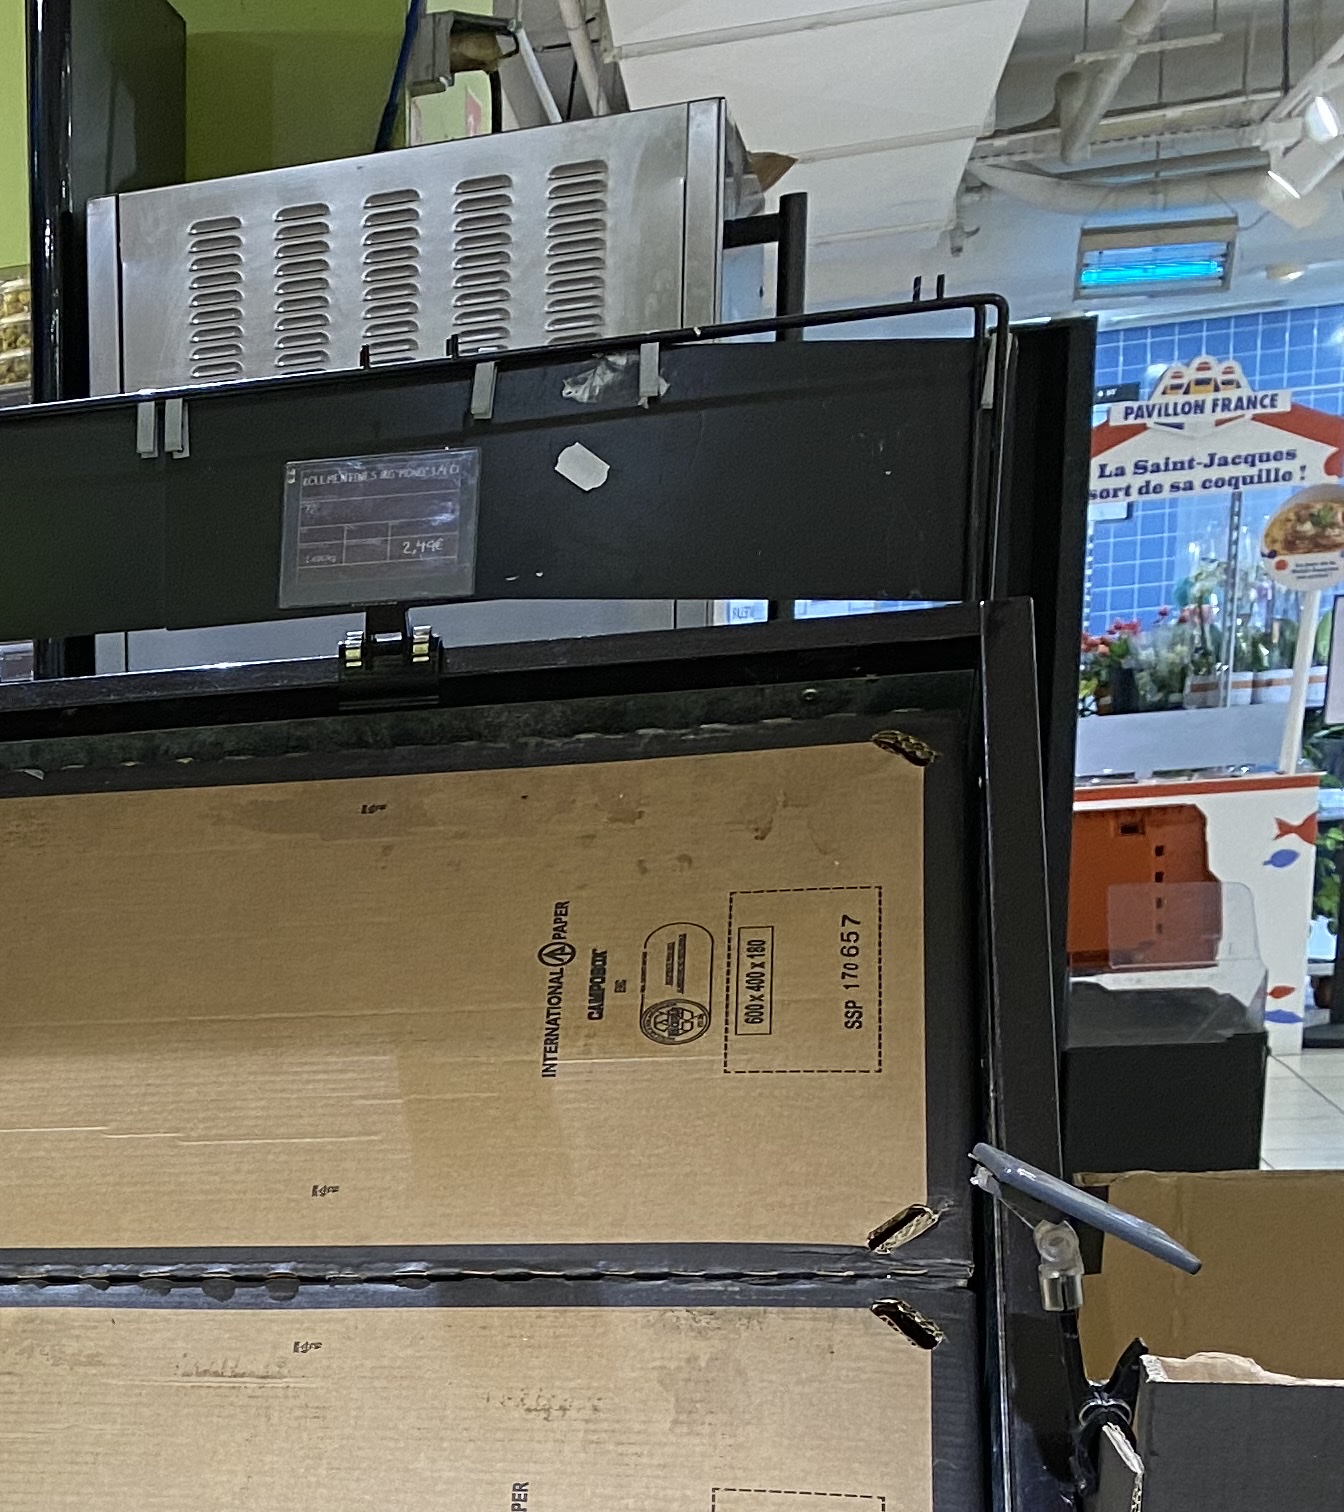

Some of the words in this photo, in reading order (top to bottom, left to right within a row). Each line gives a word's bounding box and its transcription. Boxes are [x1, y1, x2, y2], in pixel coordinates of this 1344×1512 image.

[1124, 399, 1206, 421] PAVILLON
[1212, 393, 1279, 413] FRANCE
[1098, 463, 1126, 479] La
[1133, 448, 1298, 476] Saint-Jacques
[1089, 484, 1131, 500] sort
[1138, 480, 1163, 496] de
[1169, 478, 1194, 493] sa
[1202, 467, 1293, 490] coquille
[552, 900, 571, 940] PAPER
[746, 938, 767, 960] 180
[587, 948, 608, 1021] CAMPOBOX
[745, 970, 766, 991] 400
[542, 967, 564, 1078] INTERNATIONAL
[744, 1001, 766, 1025] 600
[844, 1000, 865, 1030] SSP
